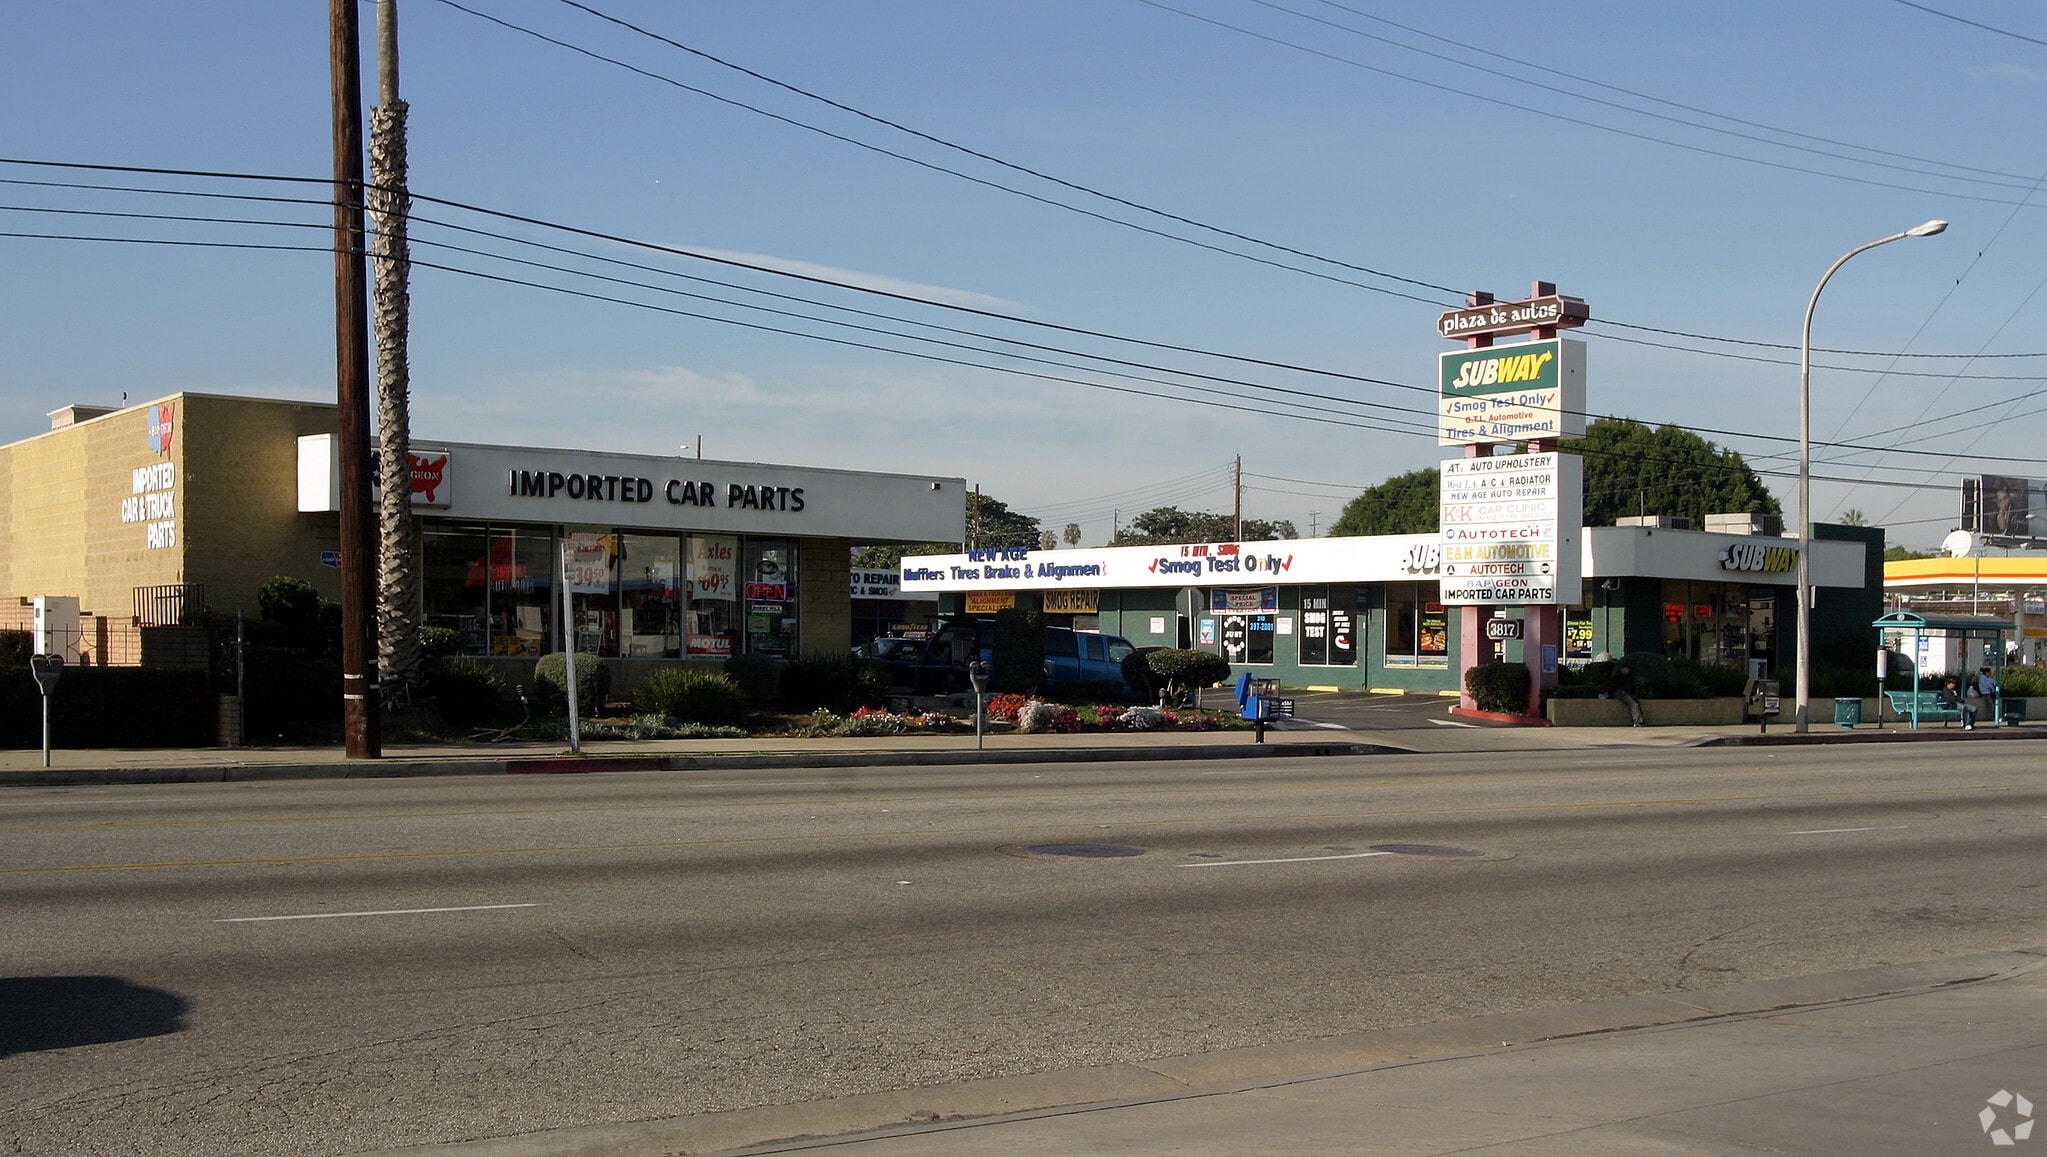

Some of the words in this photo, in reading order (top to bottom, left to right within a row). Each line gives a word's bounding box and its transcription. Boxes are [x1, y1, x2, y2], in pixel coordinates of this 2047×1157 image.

[1444, 313, 1486, 335] plaza
[1490, 308, 1507, 325] de
[1511, 302, 1557, 322] autos
[1452, 351, 1553, 389] SUBWAY
[1454, 400, 1487, 413] Smog
[1491, 395, 1515, 409] Test
[1519, 393, 1546, 407] Only
[1489, 410, 1534, 422] Automotive
[1446, 427, 1475, 439] Tires
[1479, 424, 1487, 436] &
[1491, 419, 1554, 436] Alignment
[1470, 460, 1493, 472] AUTO
[1495, 456, 1552, 469] UPHOLSTERY
[132, 461, 175, 495] IMPORTED
[410, 470, 440, 480] GEON
[1509, 474, 1551, 486] RADIATOR
[509, 469, 653, 503] IMPORTED
[664, 479, 716, 507] CAR
[727, 483, 805, 512] PARTS
[1451, 493, 1468, 501] NEW
[1472, 491, 1487, 499] AGE
[1491, 489, 1512, 498] AUTO
[1516, 487, 1546, 496] REPAIR
[122, 496, 138, 523] CAR
[139, 496, 146, 522] &
[146, 491, 175, 521] TRUCK
[1443, 506, 1473, 522] K&K
[1478, 505, 1502, 515] CAR
[1506, 503, 1546, 513] CLINIC
[147, 521, 176, 549] PARTS
[1458, 529, 1539, 540] AUTOTECH
[697, 543, 732, 560] Axles
[968, 548, 997, 562] NEW
[1001, 547, 1028, 561] AGE
[1181, 546, 1189, 556] 15
[1476, 544, 1550, 560] AUTOMOTIVE
[1719, 544, 1800, 572] SUBWAY
[950, 566, 980, 580] Tires
[984, 564, 1020, 579] Brake
[1024, 564, 1034, 578] &
[1159, 558, 1201, 577] Smog
[1206, 556, 1240, 572] Test
[1244, 554, 1281, 575] Only
[1470, 564, 1524, 575] AUTOTECH
[863, 573, 900, 585] REPAIR
[746, 583, 783, 599] OPEN
[1445, 589, 1493, 599] IMPORTED
[1495, 590, 1516, 599] CAR
[1518, 588, 1552, 599] PARTS
[1046, 591, 1068, 609] SMOG
[1070, 591, 1099, 609] REPAIR
[1304, 600, 1311, 609] 15
[1313, 599, 1327, 609] MIN
[1304, 612, 1326, 624] SMOG
[1305, 626, 1325, 638] TEST
[1490, 623, 1515, 636] 3817
[1568, 629, 1592, 640] $7.99
[690, 638, 730, 649] MOTUL
